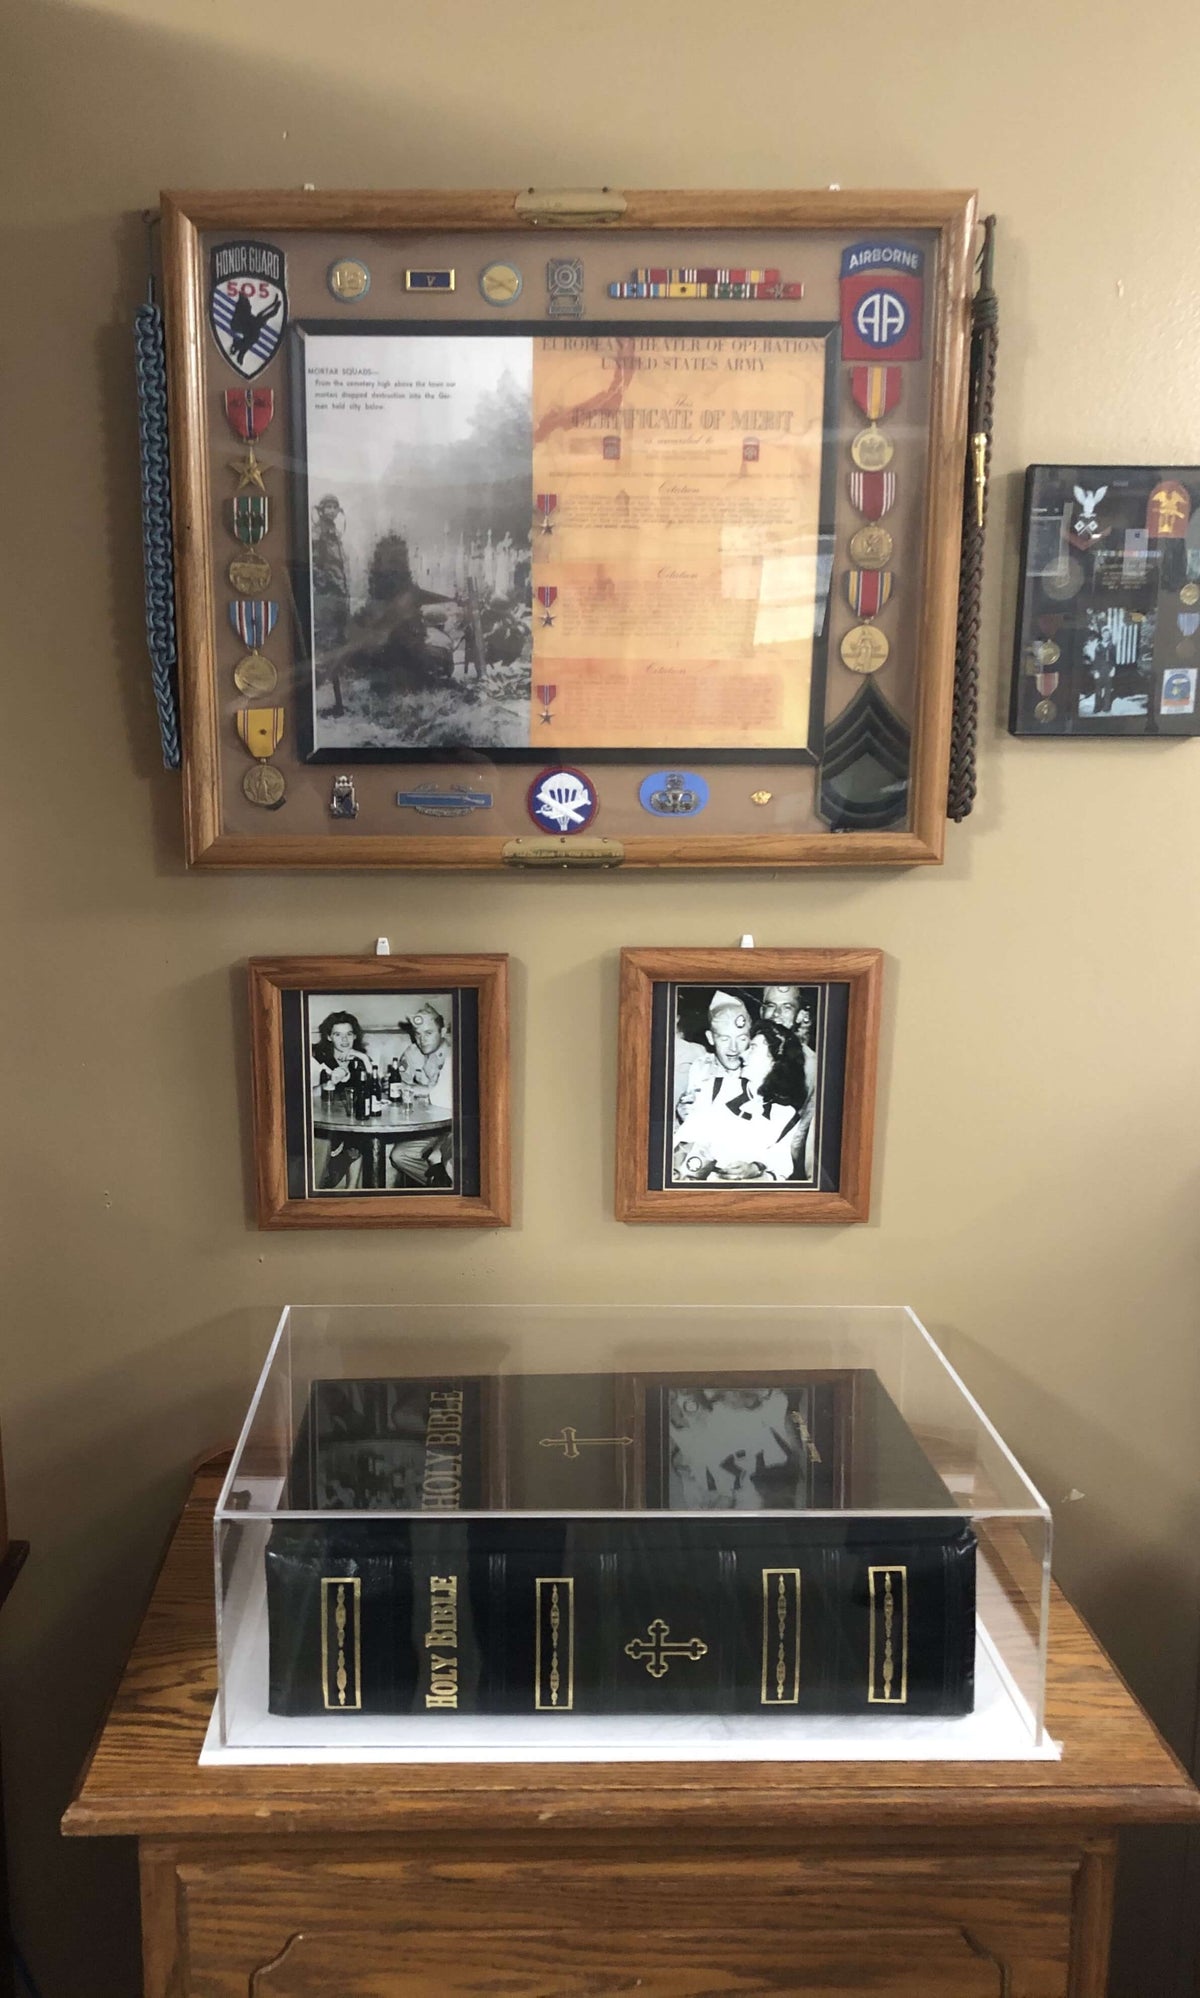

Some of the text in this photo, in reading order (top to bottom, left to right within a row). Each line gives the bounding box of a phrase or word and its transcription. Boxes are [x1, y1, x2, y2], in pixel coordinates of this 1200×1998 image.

[215, 246, 280, 280] HONOR GUARD
[849, 247, 919, 269] AIRBORNE
[226, 281, 270, 299] 505
[857, 293, 905, 342] AA
[706, 338, 724, 352] OF
[731, 338, 825, 353] OPERATIONS
[307, 367, 338, 375] MORTAR
[663, 357, 719, 371] STATES
[726, 357, 765, 372] ARMY
[315, 379, 331, 387] From
[571, 407, 794, 432] CERTIFICATE OF MERIT
[421, 1390, 463, 1511] HOLY BIBLE
